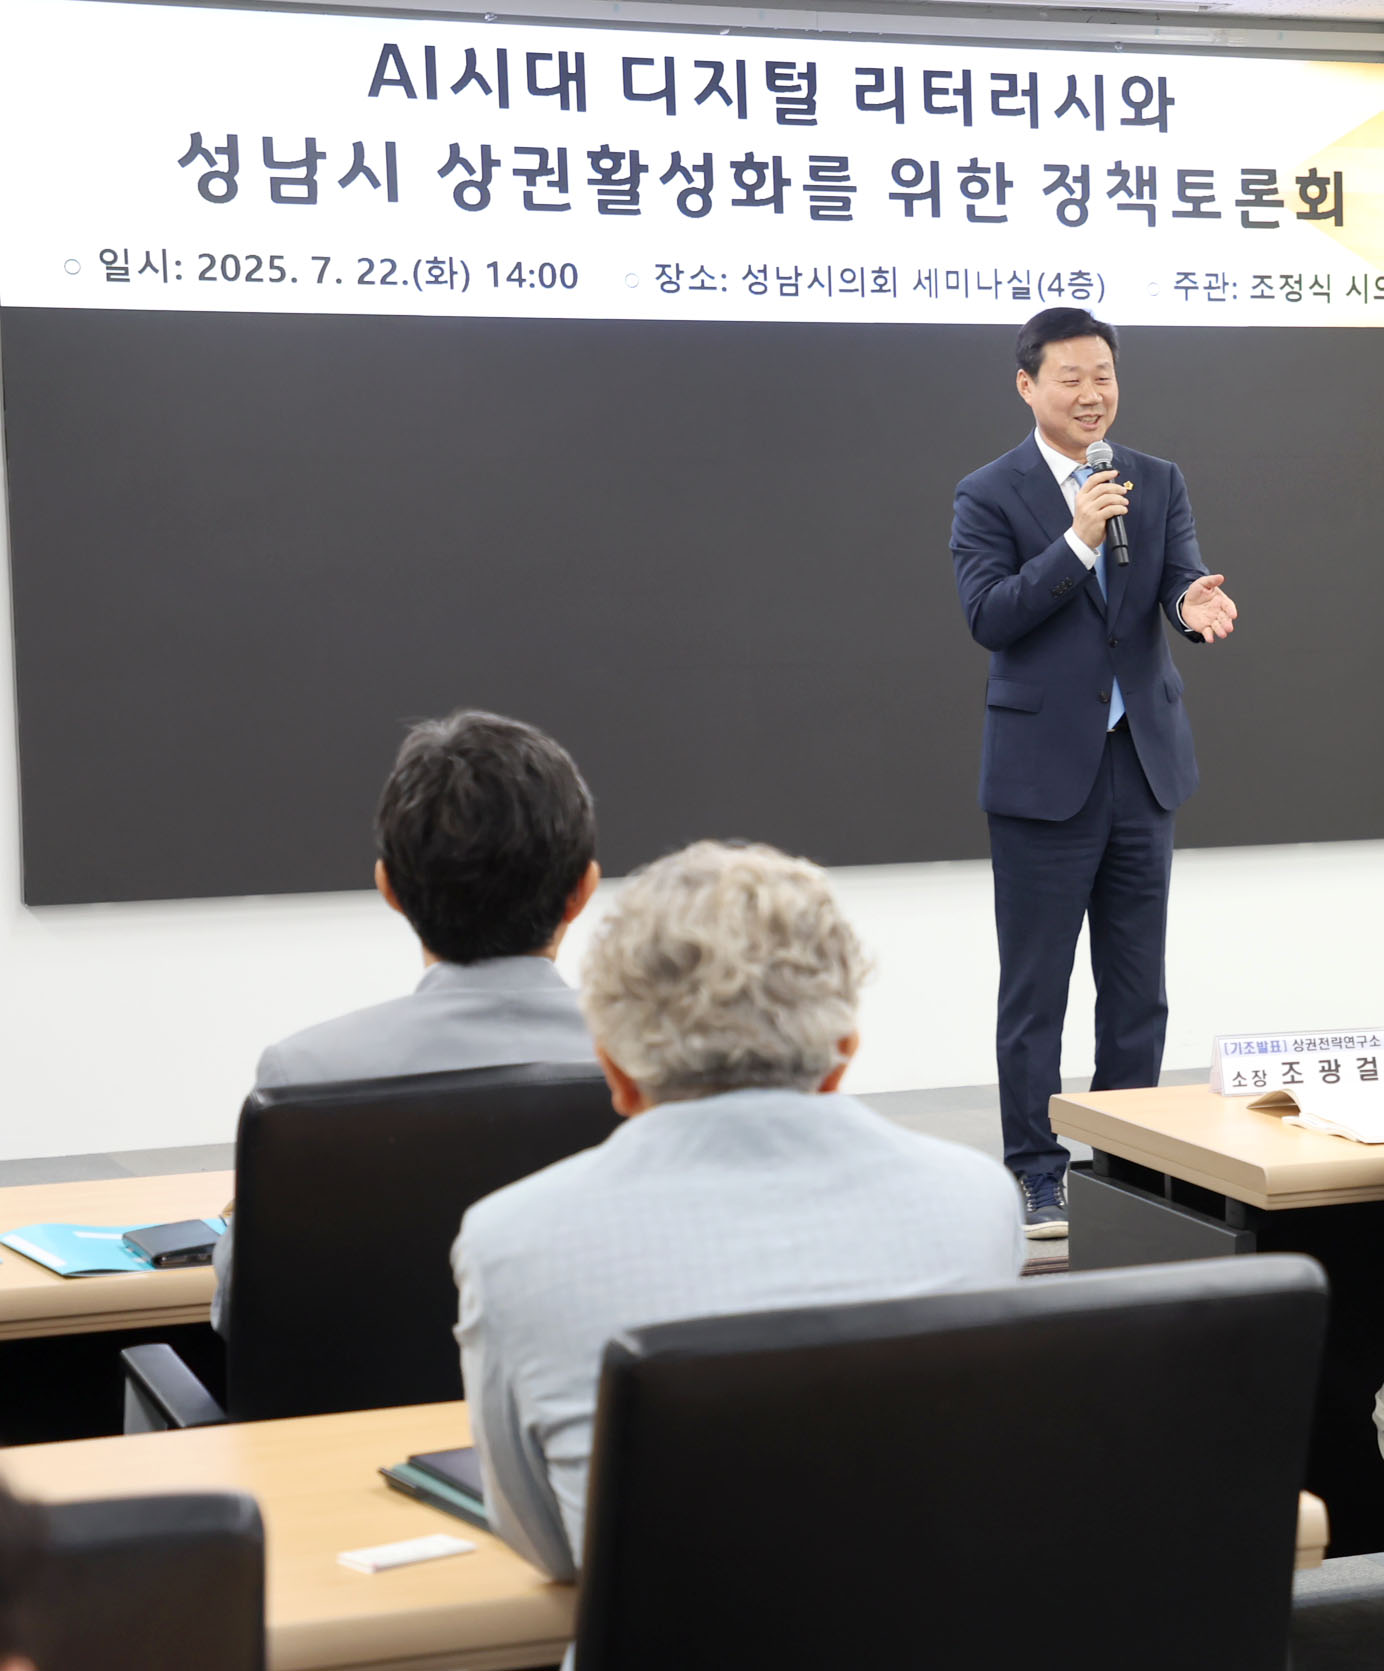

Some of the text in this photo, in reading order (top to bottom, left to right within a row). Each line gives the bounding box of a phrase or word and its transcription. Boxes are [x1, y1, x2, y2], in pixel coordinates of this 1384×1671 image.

[368, 43, 1175, 134] AI시대 디지털 리터러시와
[178, 132, 1344, 229] 성남시 상권활성화를 위한 정책토론회
[99, 248, 578, 293] 일시: 2025. 7. 22.(화) 14:00
[655, 263, 1106, 303] 장소: 성남시의회 세미나실(4층)
[1173, 271, 1238, 302] 주관:
[1250, 273, 1331, 303] 조정식
[1292, 1035, 1382, 1053] 상권전략연구소
[1232, 1070, 1267, 1088] 소장
